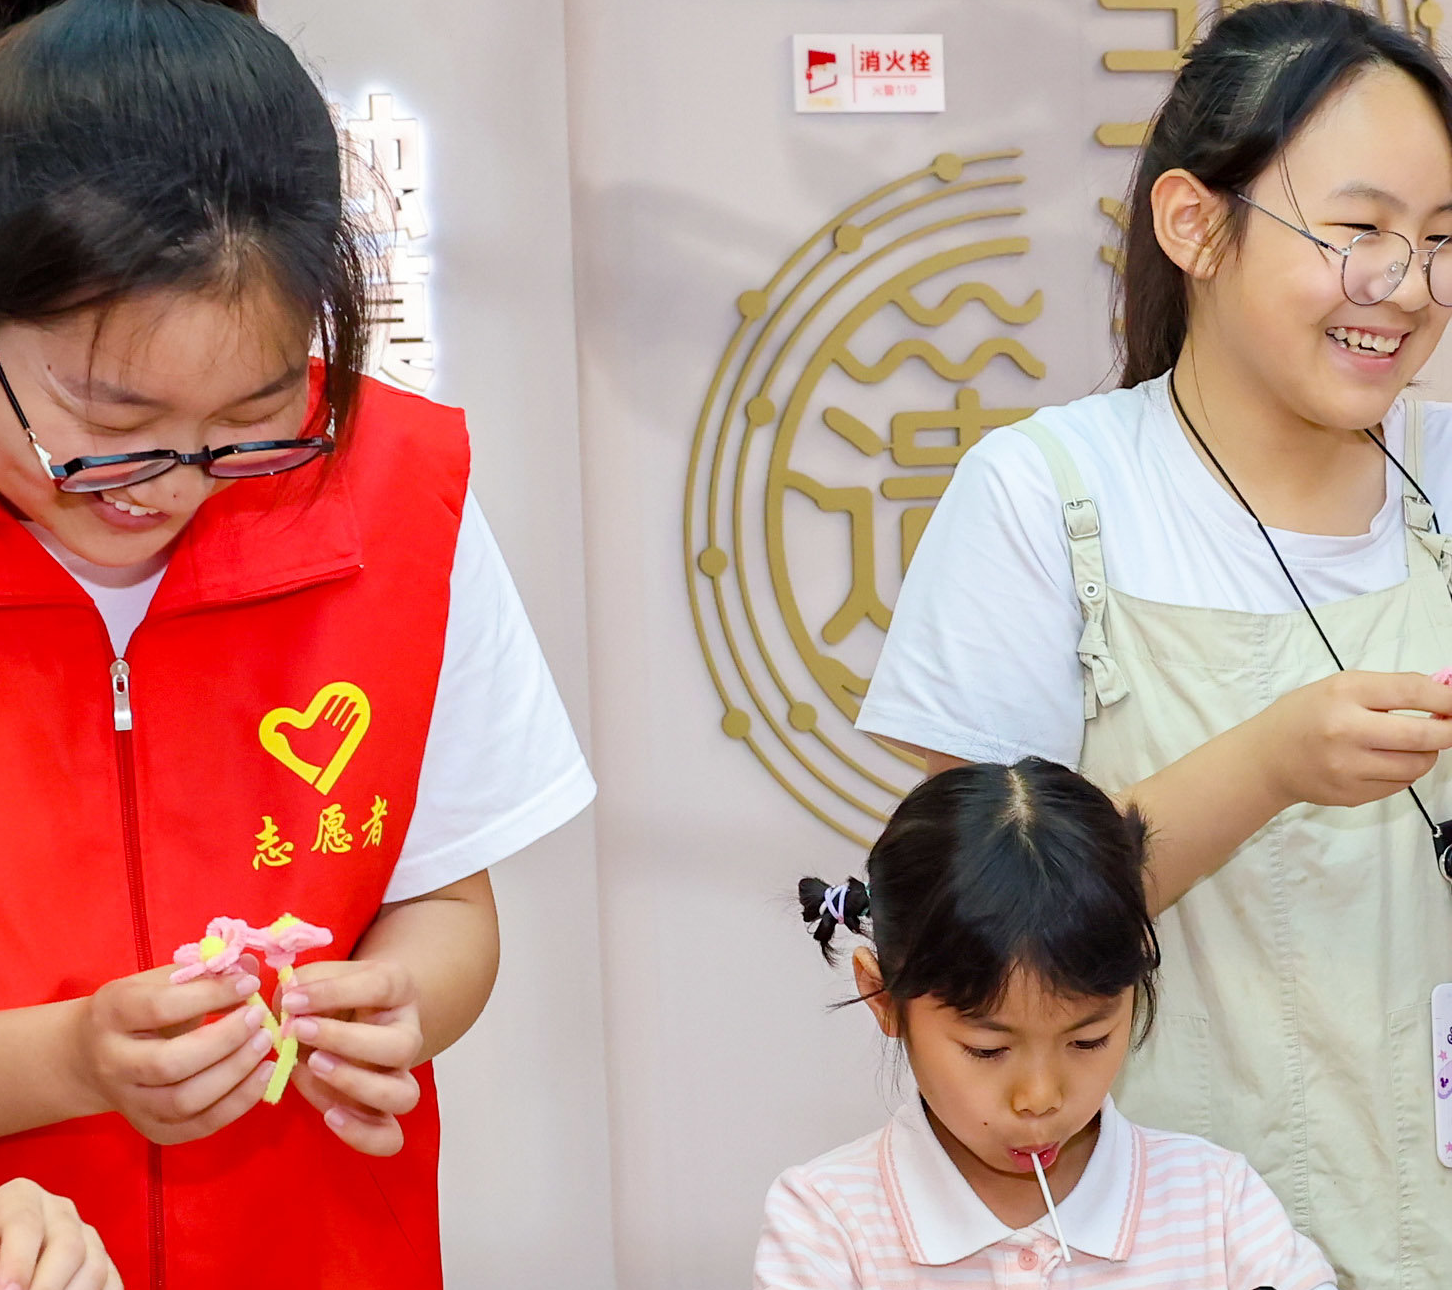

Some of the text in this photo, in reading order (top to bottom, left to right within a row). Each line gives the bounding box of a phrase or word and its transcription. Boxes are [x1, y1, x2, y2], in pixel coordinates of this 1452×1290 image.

[859, 49, 931, 72] 消火栓
[252, 795, 388, 870] 志愿者
